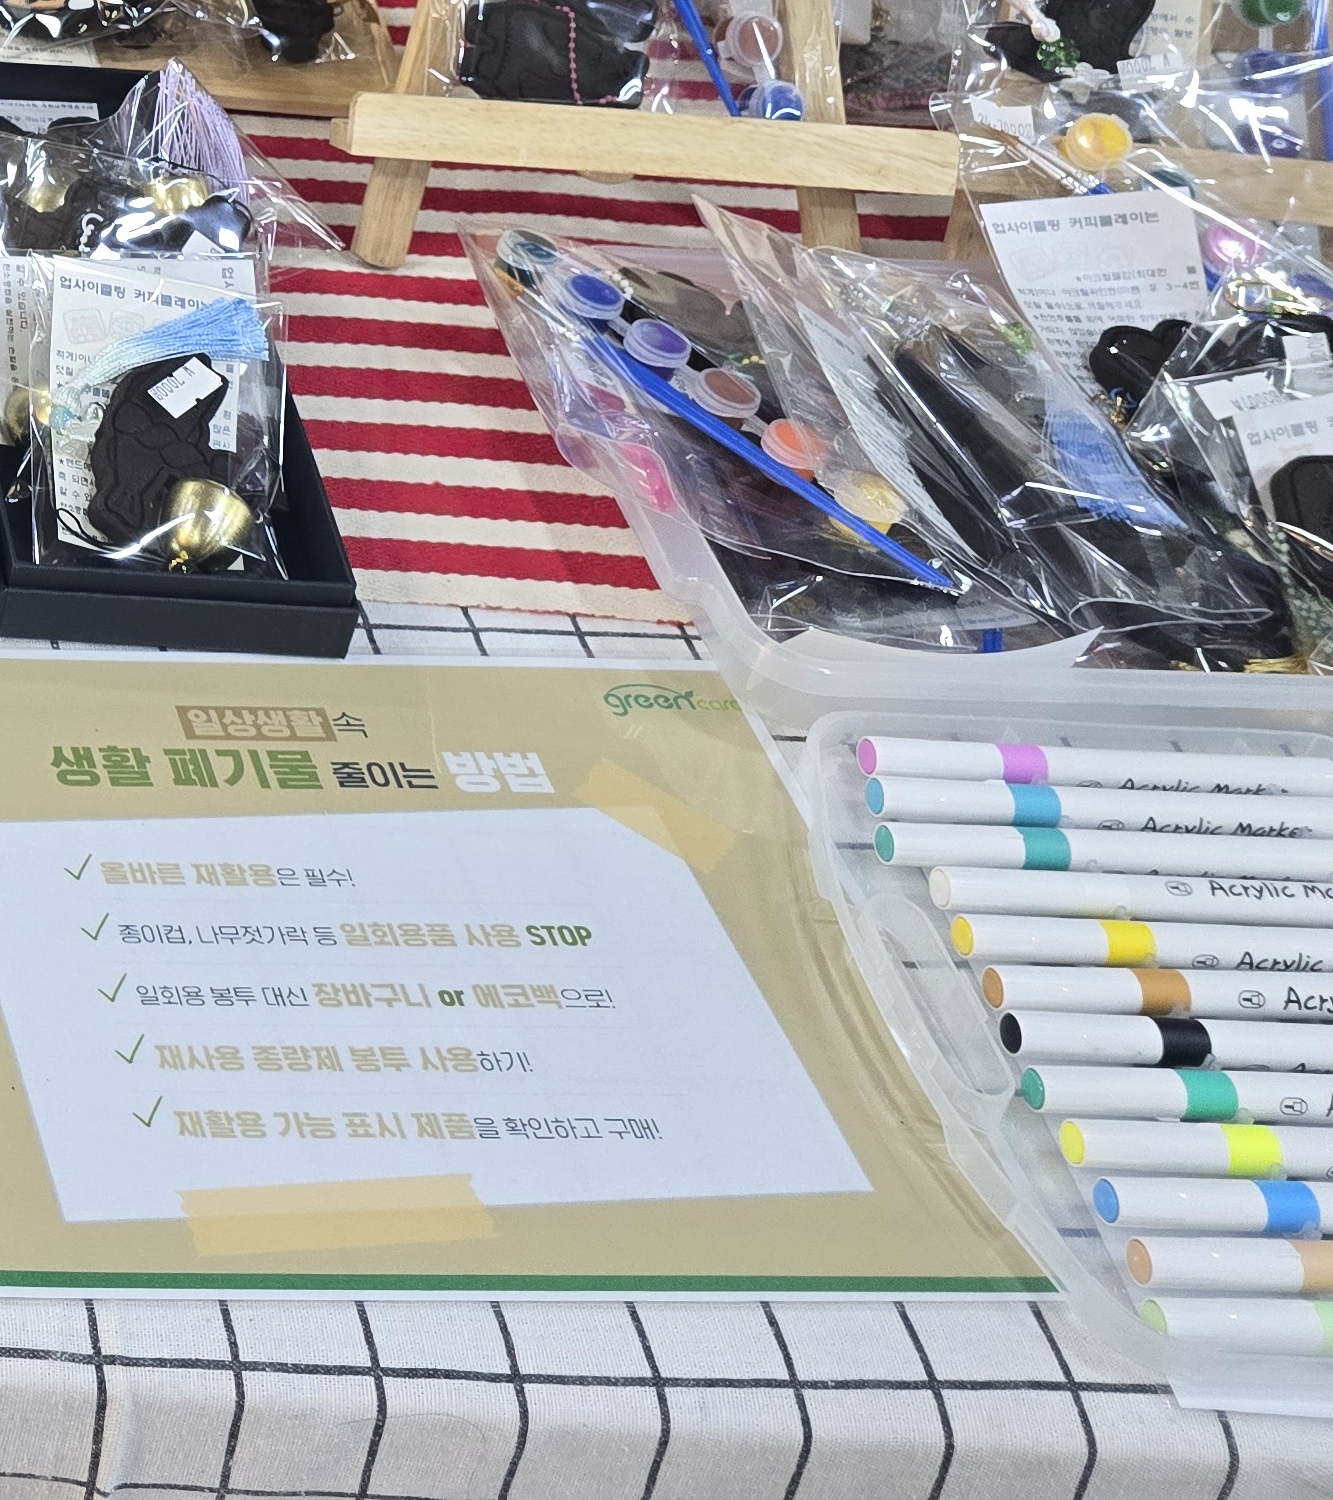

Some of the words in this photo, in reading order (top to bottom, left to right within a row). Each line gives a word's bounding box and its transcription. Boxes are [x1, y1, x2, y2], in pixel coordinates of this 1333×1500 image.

[59, 275, 127, 299] 업사이클링
[1246, 420, 1319, 446] 업사이클링
[186, 707, 327, 739] 일상생활
[332, 710, 369, 739] 속
[50, 745, 154, 790] 생활
[163, 747, 324, 790] 폐기물
[331, 760, 439, 791] 줄이는
[442, 750, 555, 794] 방법
[100, 861, 186, 886] 올바른
[190, 862, 300, 887] 재활용은
[303, 867, 356, 888] 필수!
[1208, 879, 1296, 900] Acrylic
[118, 923, 193, 946] 종이컵,
[195, 925, 309, 946] 나무젓가락
[312, 926, 338, 947] 등
[339, 922, 458, 948] 일회용품
[463, 922, 522, 948] 사용
[525, 924, 593, 948] STOP
[1235, 951, 1324, 973] Acrylic
[136, 985, 207, 1007] 일회용
[209, 986, 258, 1008] 봉투
[261, 986, 310, 1008] 대신
[311, 983, 433, 1009] 장바구니
[437, 988, 466, 1008] or
[471, 984, 617, 1010] 에코백으로!
[154, 1044, 246, 1073] 재사용
[250, 1044, 345, 1073] 종량제
[348, 1045, 412, 1073] 봉투
[419, 1045, 534, 1073] 사용하기!
[173, 1110, 268, 1140] 재활용
[273, 1111, 337, 1140] 가능
[342, 1112, 408, 1140] 표시
[410, 1112, 502, 1141] 제품을
[502, 1116, 603, 1141] 확인하고
[604, 1116, 665, 1141] 구매!
